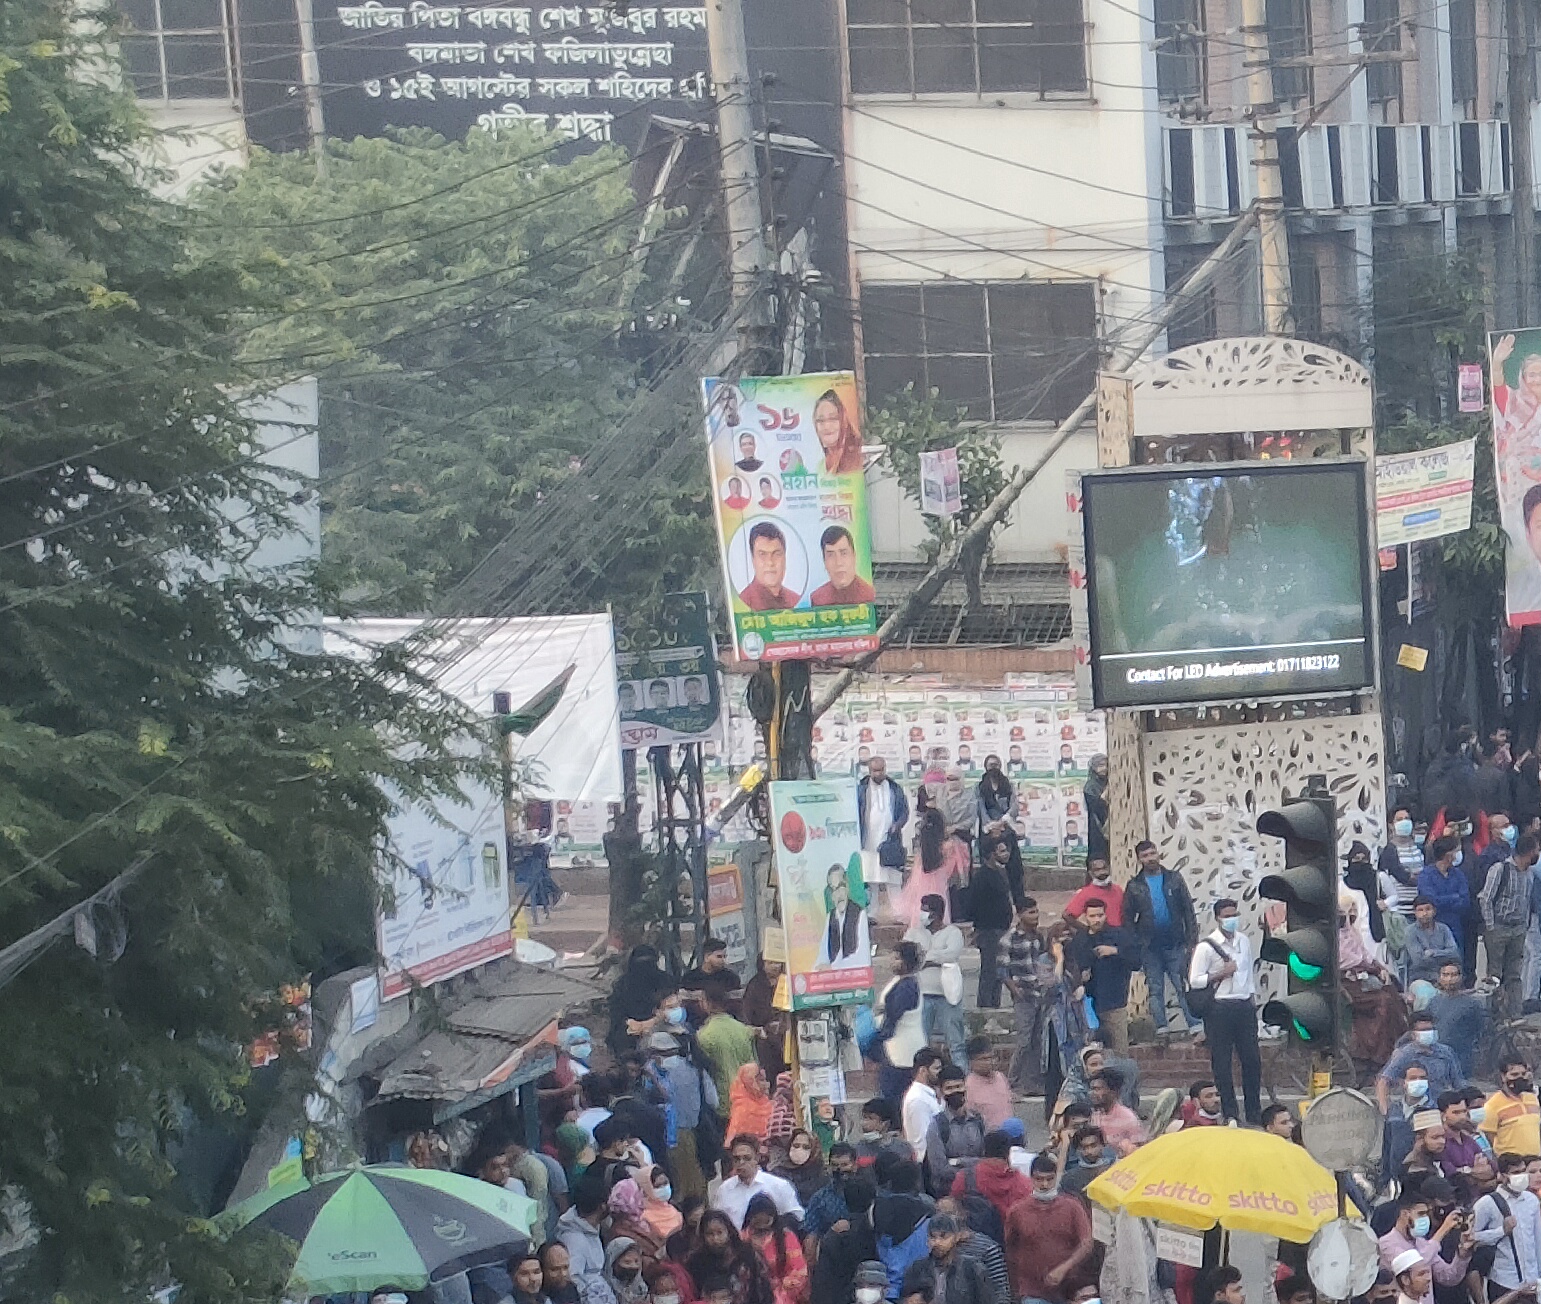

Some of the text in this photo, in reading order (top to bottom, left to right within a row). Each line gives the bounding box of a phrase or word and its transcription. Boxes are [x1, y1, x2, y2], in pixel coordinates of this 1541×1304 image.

[337, 3, 404, 29] জাতির
[410, 2, 460, 29] পিতা
[465, 6, 531, 35] বঙ্গবন্ধু
[538, 6, 582, 30] শেখ
[662, 6, 709, 30] রহম
[404, 41, 487, 64] বঙ্গমাতা
[493, 42, 536, 64] শেখ
[364, 80, 381, 98] ও
[390, 73, 437, 100] ১৫ই
[440, 75, 532, 100] আগস্টের
[536, 77, 592, 99] সকল
[597, 73, 674, 101] শহিদের
[554, 111, 614, 142] শ্রদ্ধা
[757, 403, 801, 432] ১৬
[781, 473, 818, 490] মহান
[1126, 667, 1165, 683] Contact
[1167, 665, 1184, 681] For
[1184, 663, 1204, 680] LED
[1204, 660, 1275, 678] Advertisement:
[1142, 1180, 1299, 1216] skitto skitto
[331, 1250, 377, 1261] eScan
